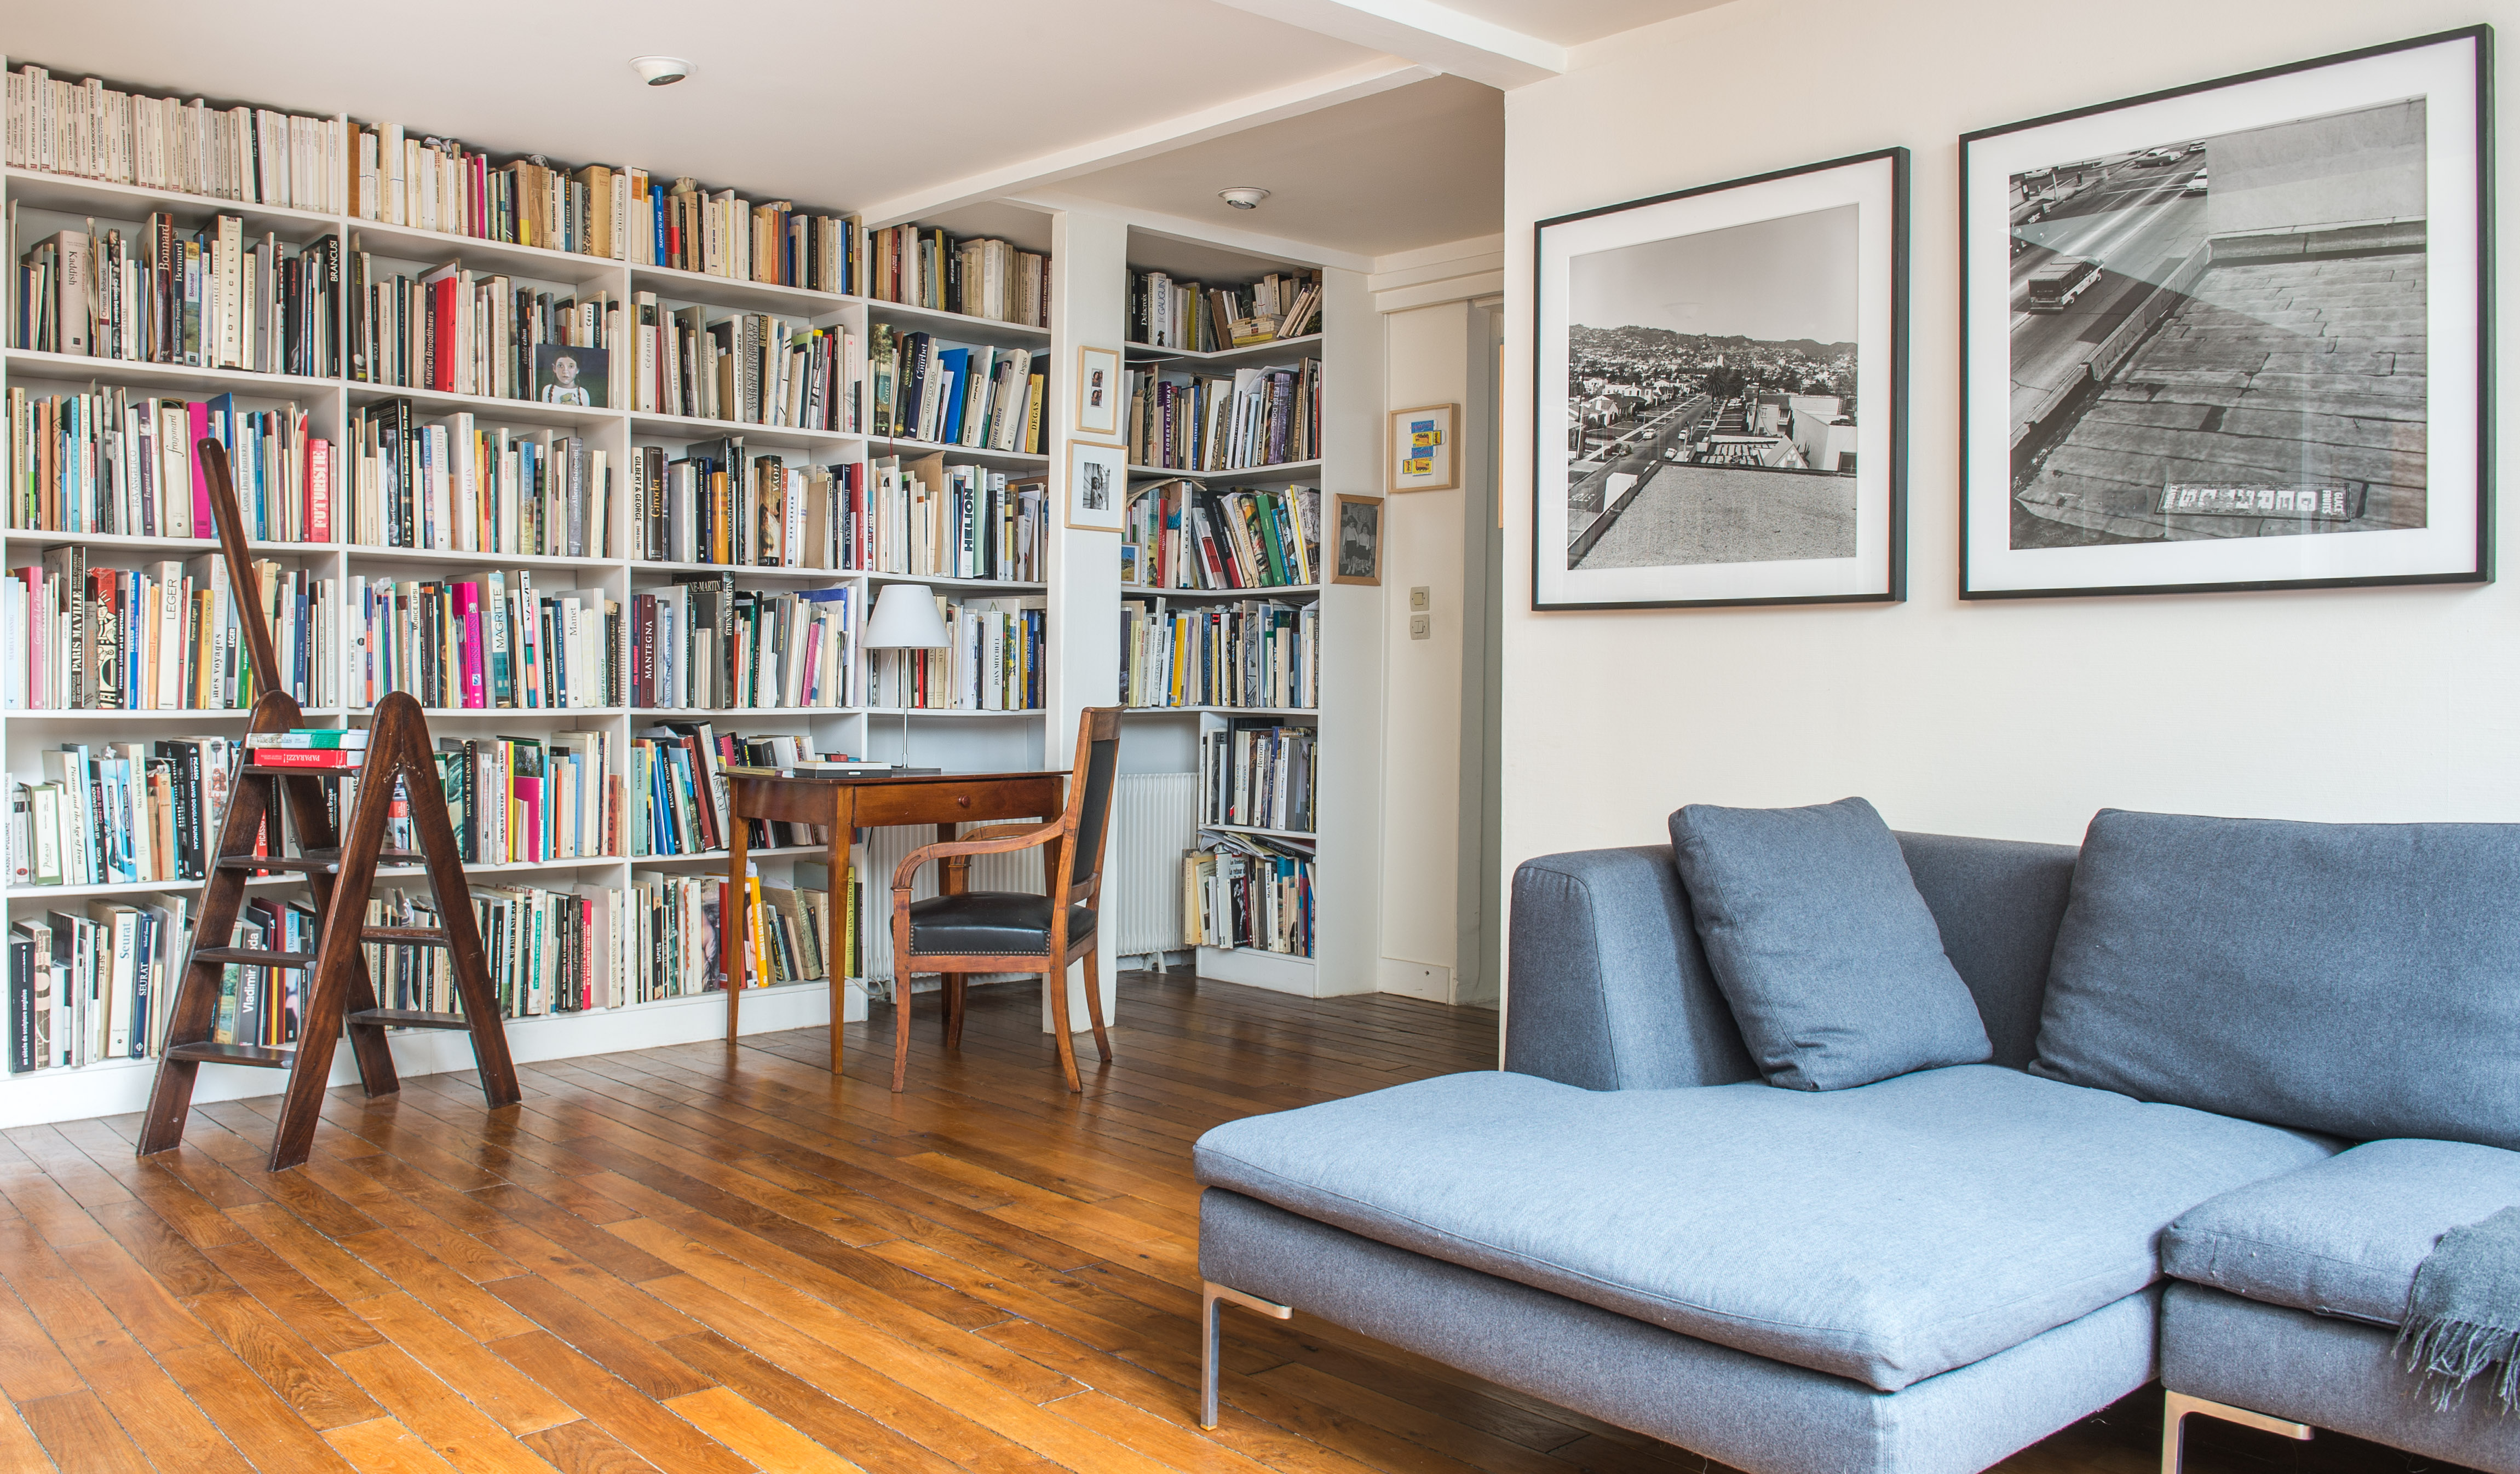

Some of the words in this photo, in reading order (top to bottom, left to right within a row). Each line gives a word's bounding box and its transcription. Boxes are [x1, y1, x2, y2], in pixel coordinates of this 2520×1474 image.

[159, 223, 170, 270] Bonnard
[69, 251, 77, 285] Kaddish
[425, 311, 434, 356] Broodthaers
[917, 343, 927, 379] Courbet
[1019, 356, 1028, 375] Degas
[166, 414, 184, 457] fragonard
[994, 408, 1002, 427] Debré
[435, 431, 445, 473] Gauguin
[991, 428, 999, 450] Olivier
[241, 493, 249, 512] CASPAR
[650, 479, 660, 517] Girodet
[965, 488, 973, 551] HELION
[34, 603, 41, 611] La
[72, 591, 82, 620] VILLE
[166, 579, 177, 619] LEGER
[72, 621, 82, 638] MA
[469, 613, 477, 642] PICASSO
[493, 589, 504, 648] MAGRITTE
[72, 641, 82, 671] PARIS
[214, 634, 222, 673] voyages
[470, 645, 479, 674] MATISSE
[711, 769, 726, 811] POUSSIN
[120, 922, 131, 959] Seurat
[139, 962, 148, 996] SEURAT
[243, 969, 256, 1012] Vladimir
